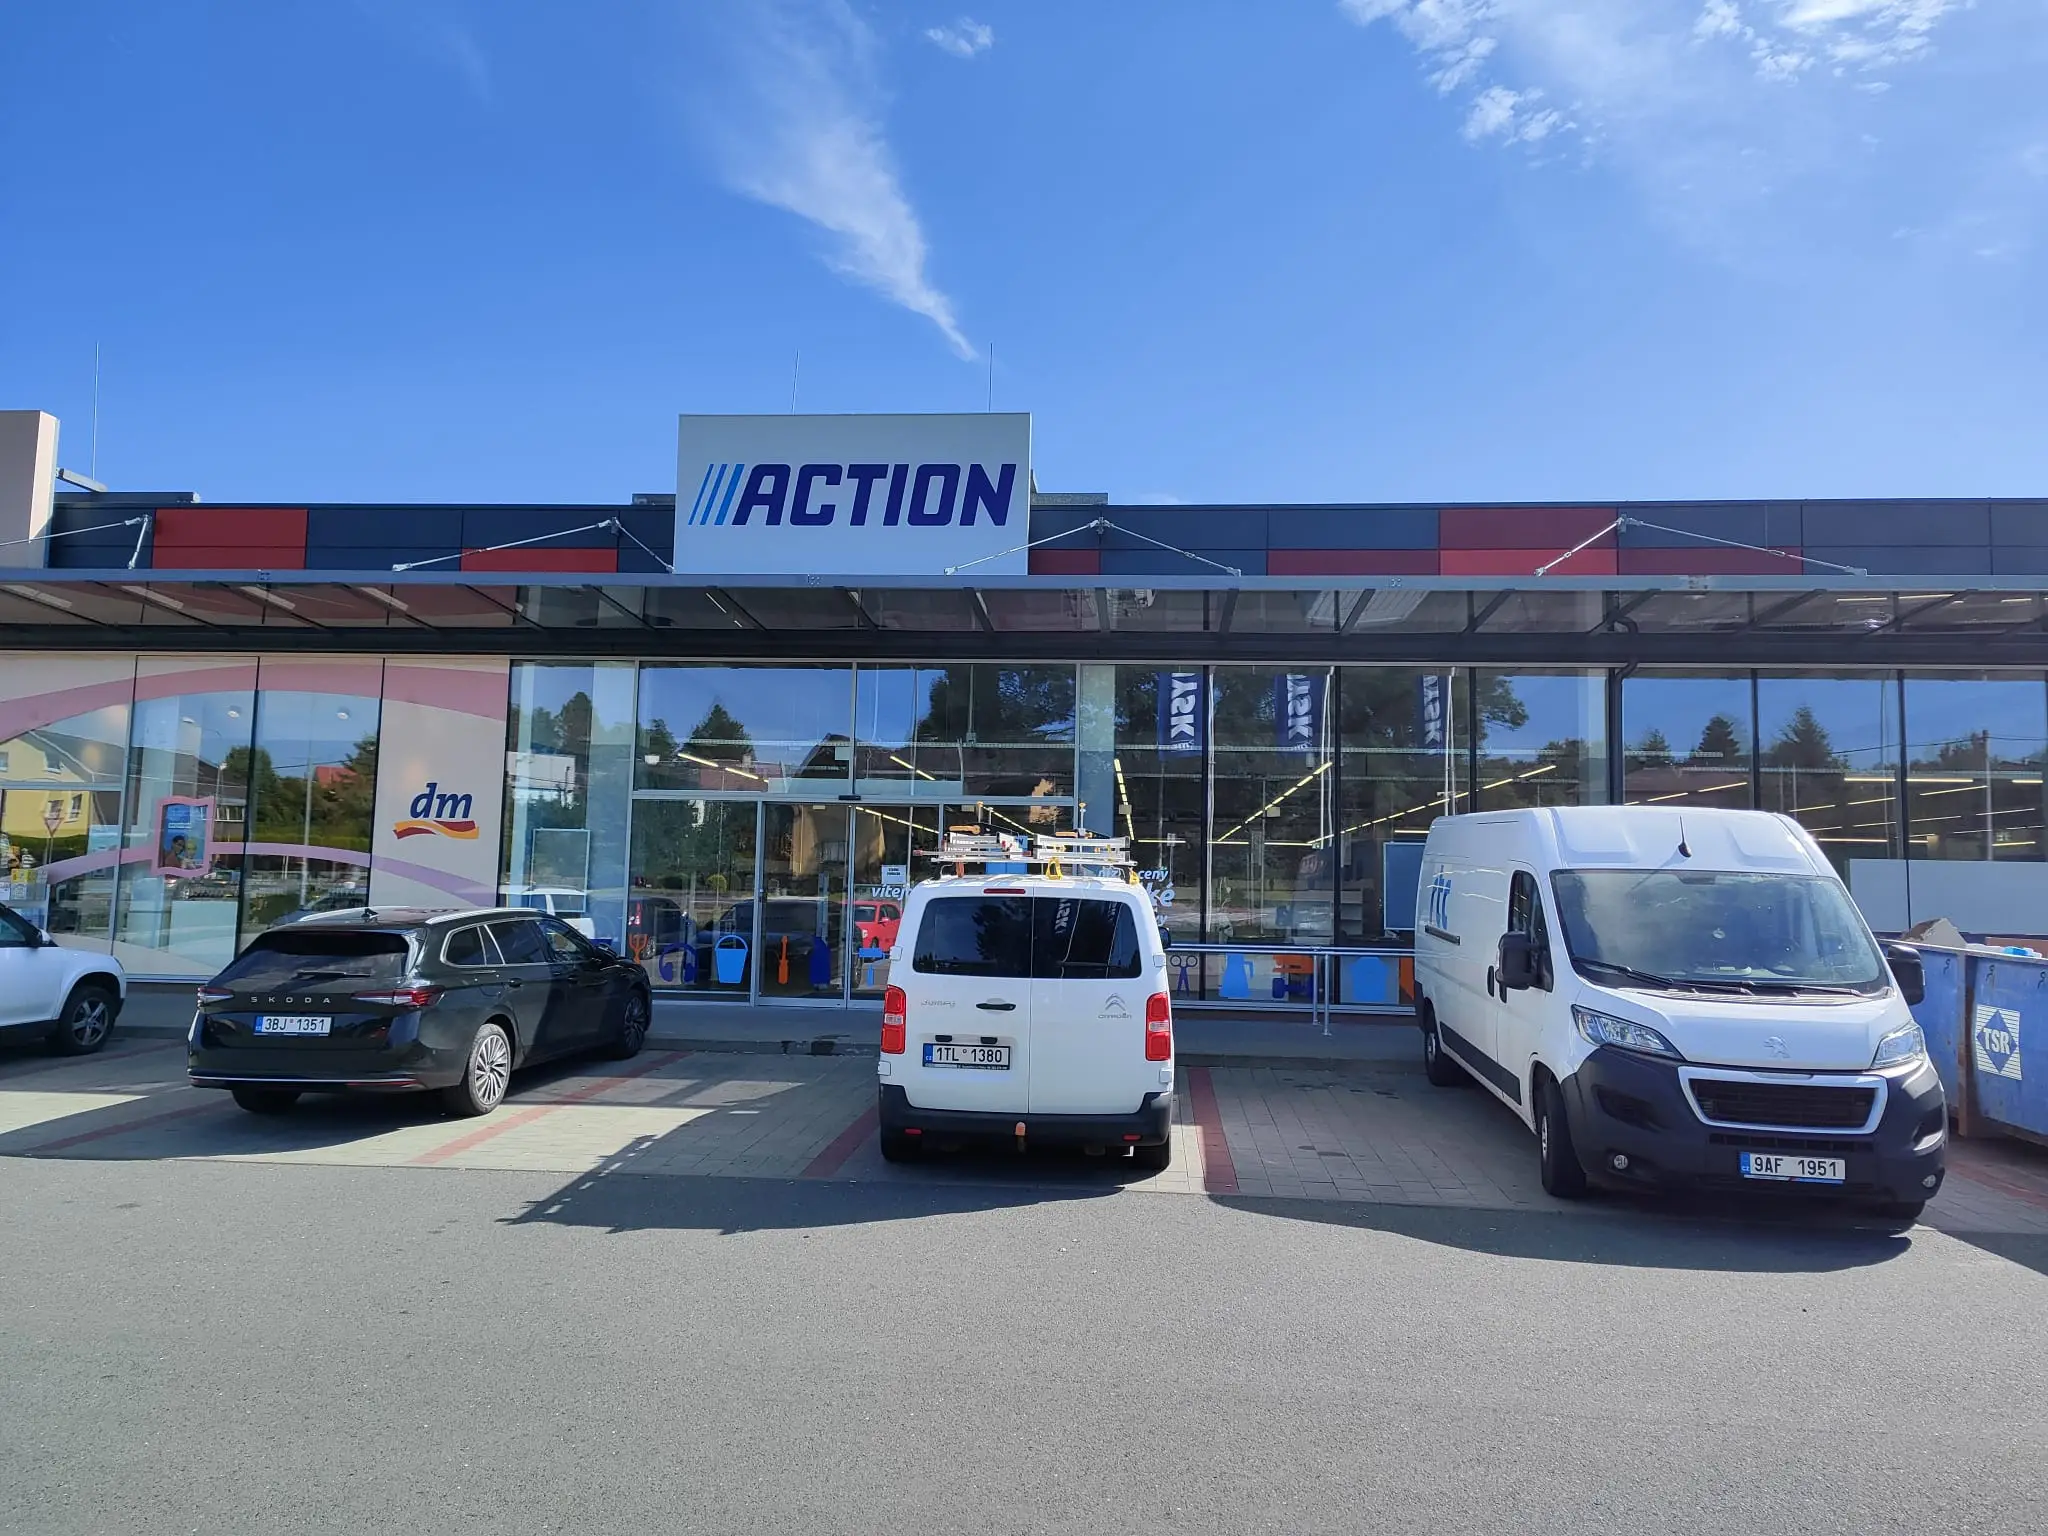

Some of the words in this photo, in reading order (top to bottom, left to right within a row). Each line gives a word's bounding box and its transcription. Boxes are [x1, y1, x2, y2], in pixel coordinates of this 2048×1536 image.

[731, 463, 1017, 527] ACTION
[409, 782, 473, 819] dm
[264, 1018, 288, 1031] 3BJ
[296, 1018, 325, 1031] 1351
[1982, 1027, 2011, 1055] TSR
[936, 1047, 960, 1062] 1TL
[971, 1048, 1003, 1063] 1380
[1754, 1157, 1784, 1174] 9AF
[1797, 1160, 1838, 1177] 1951
